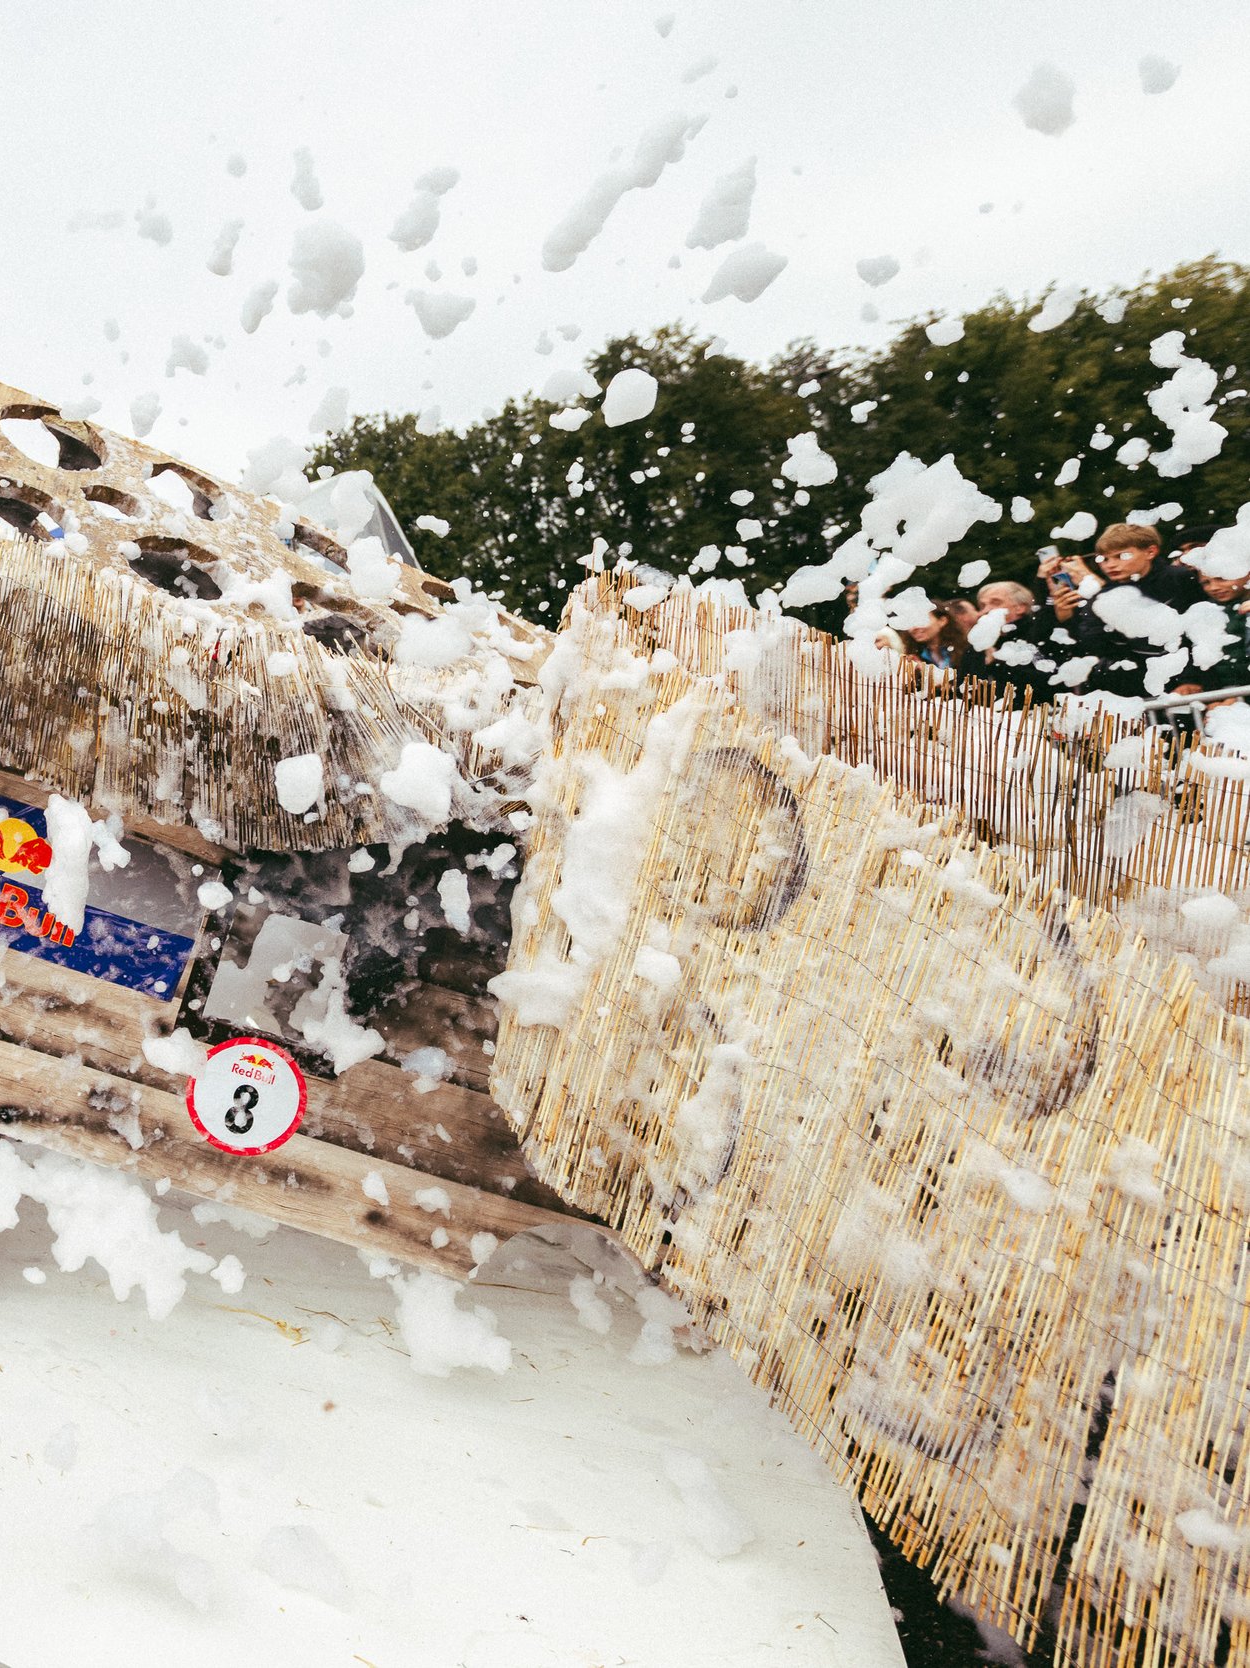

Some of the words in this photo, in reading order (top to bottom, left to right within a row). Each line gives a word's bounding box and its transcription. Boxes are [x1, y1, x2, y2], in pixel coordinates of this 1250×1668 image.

[231, 1062, 254, 1079] Red
[254, 1069, 276, 1085] Bull
[224, 1084, 260, 1135] 8
